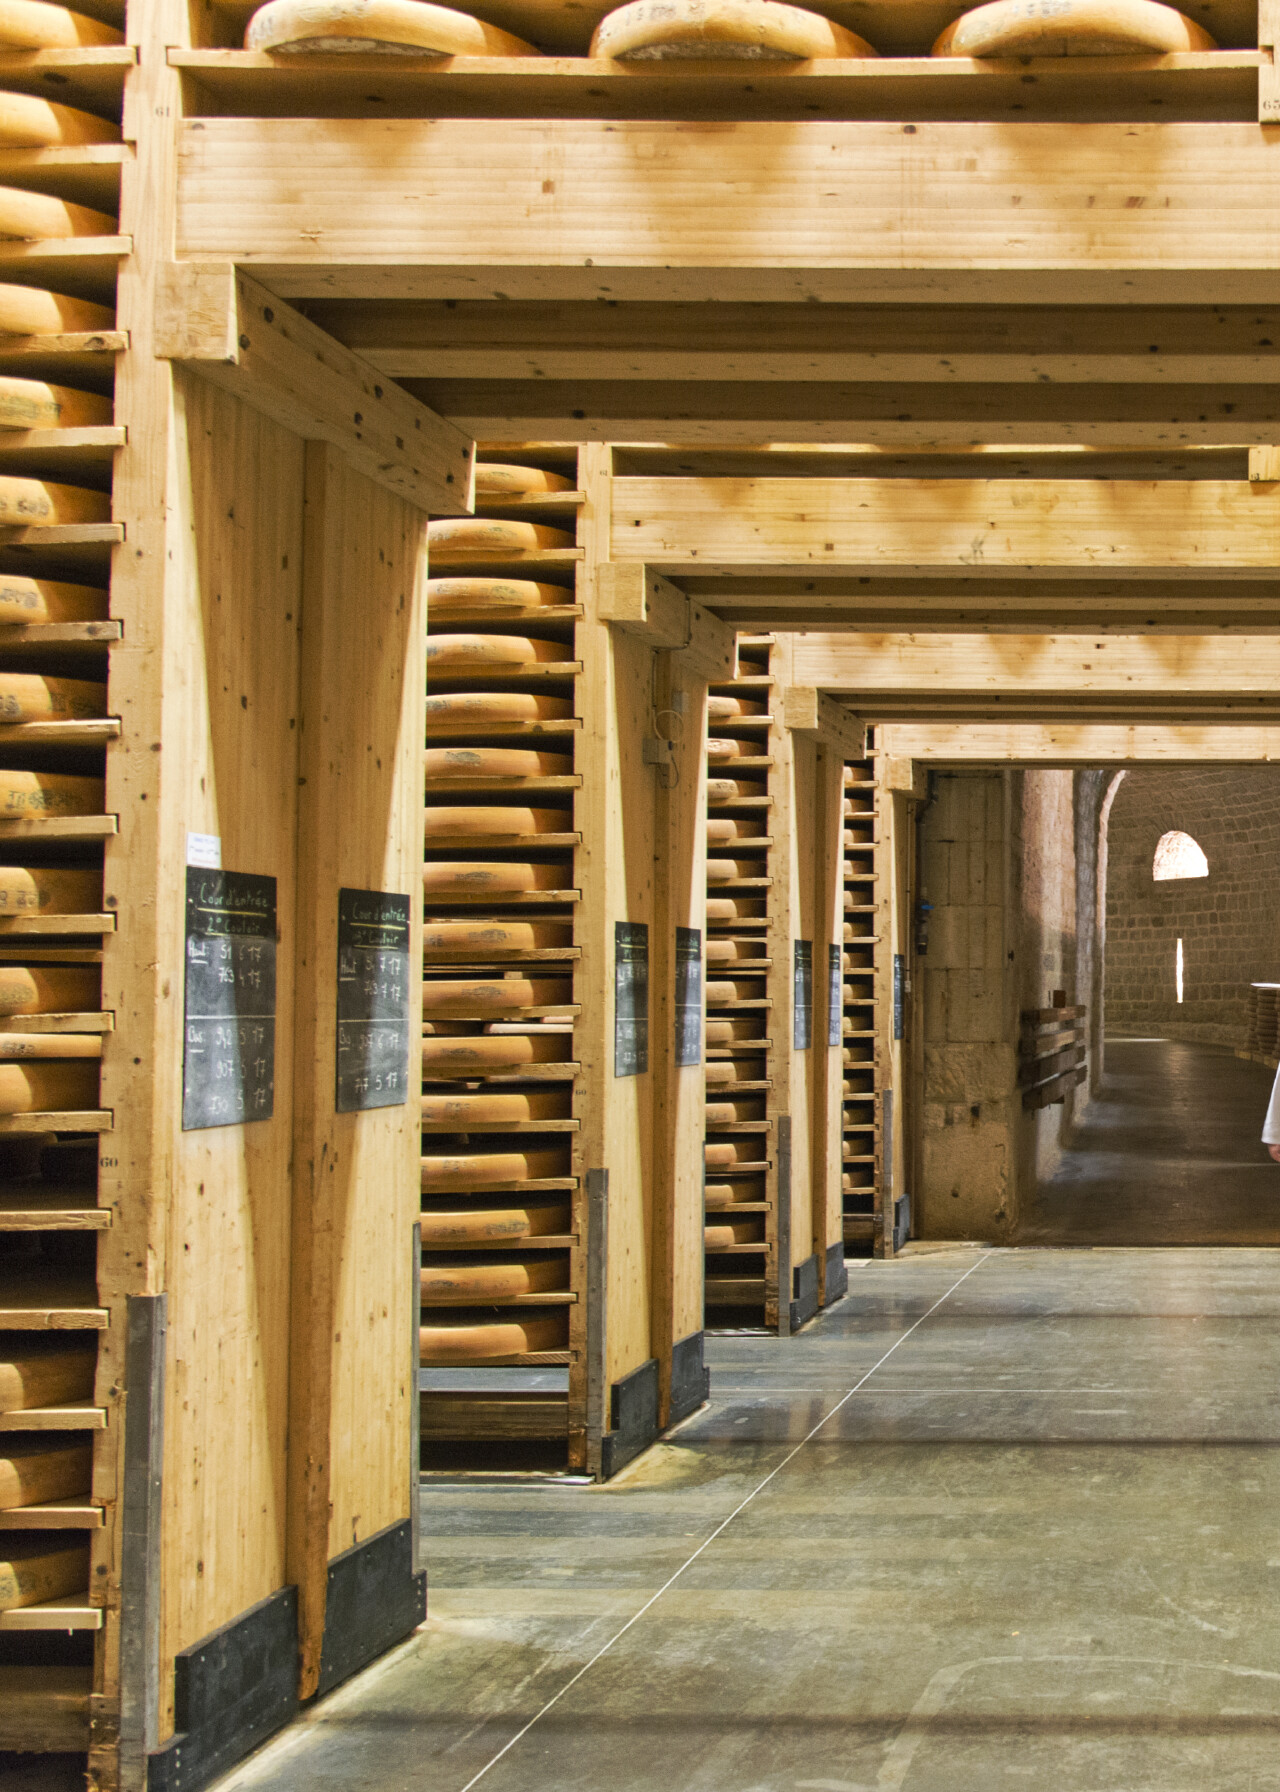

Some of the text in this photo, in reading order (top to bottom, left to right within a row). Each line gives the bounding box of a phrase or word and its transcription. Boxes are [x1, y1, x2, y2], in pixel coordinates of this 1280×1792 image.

[200, 882, 224, 904] Cour
[248, 946, 262, 963] 17
[388, 957, 401, 976] 17
[252, 1024, 264, 1044] 17
[253, 1057, 265, 1078] 17
[376, 1075, 382, 1090] 5
[386, 1071, 398, 1088] 17
[253, 1087, 266, 1109] 17
[100, 1157, 118, 1168] 60
